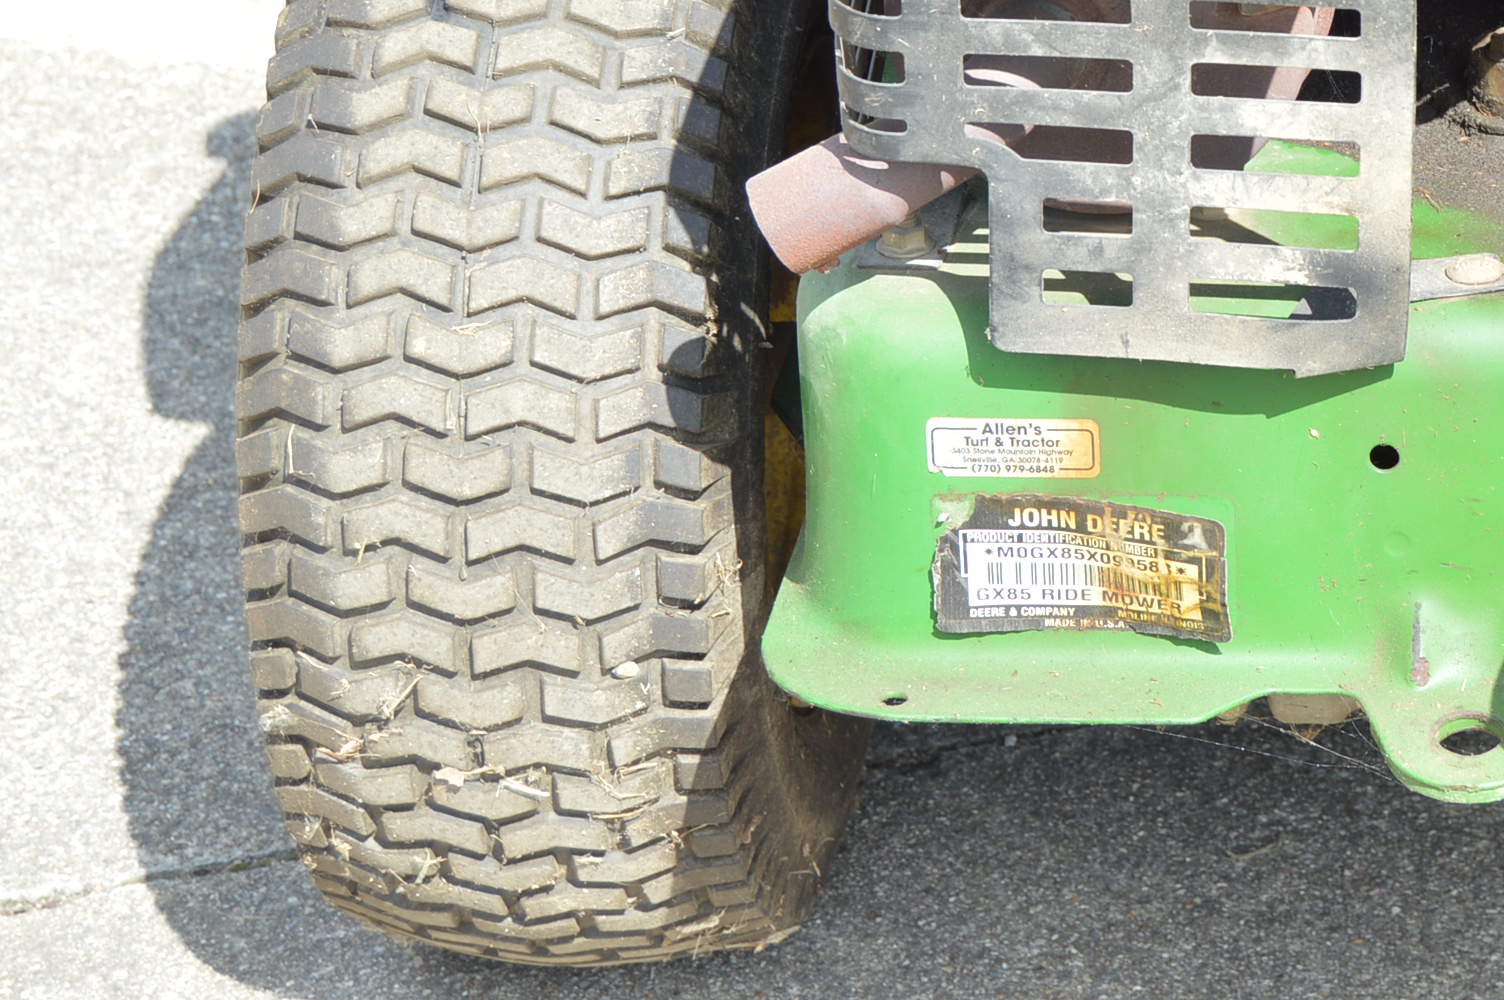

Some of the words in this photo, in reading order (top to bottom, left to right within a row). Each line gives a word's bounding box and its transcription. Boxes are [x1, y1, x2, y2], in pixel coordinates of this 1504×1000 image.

[982, 422, 1042, 435] Allen's
[964, 436, 989, 447] Turf
[994, 437, 1004, 447] &
[1009, 437, 1061, 447] Tractor
[1038, 449, 1074, 457] Highway
[971, 464, 1001, 474] (770)
[1005, 465, 1055, 474] 979-6848
[1008, 507, 1077, 530] JOHN
[1087, 513, 1165, 543] DEERE
[966, 532, 1019, 543] PRODUCT
[1022, 532, 1108, 549] IDENTIFICATION
[976, 587, 1032, 601] GX85
[1041, 588, 1093, 601] RIDE
[1102, 589, 1182, 614] MOWER
[970, 606, 1006, 617] DEERE
[1008, 606, 1018, 617] &
[1020, 606, 1076, 617] COMPANY
[1045, 618, 1077, 627] MADE
